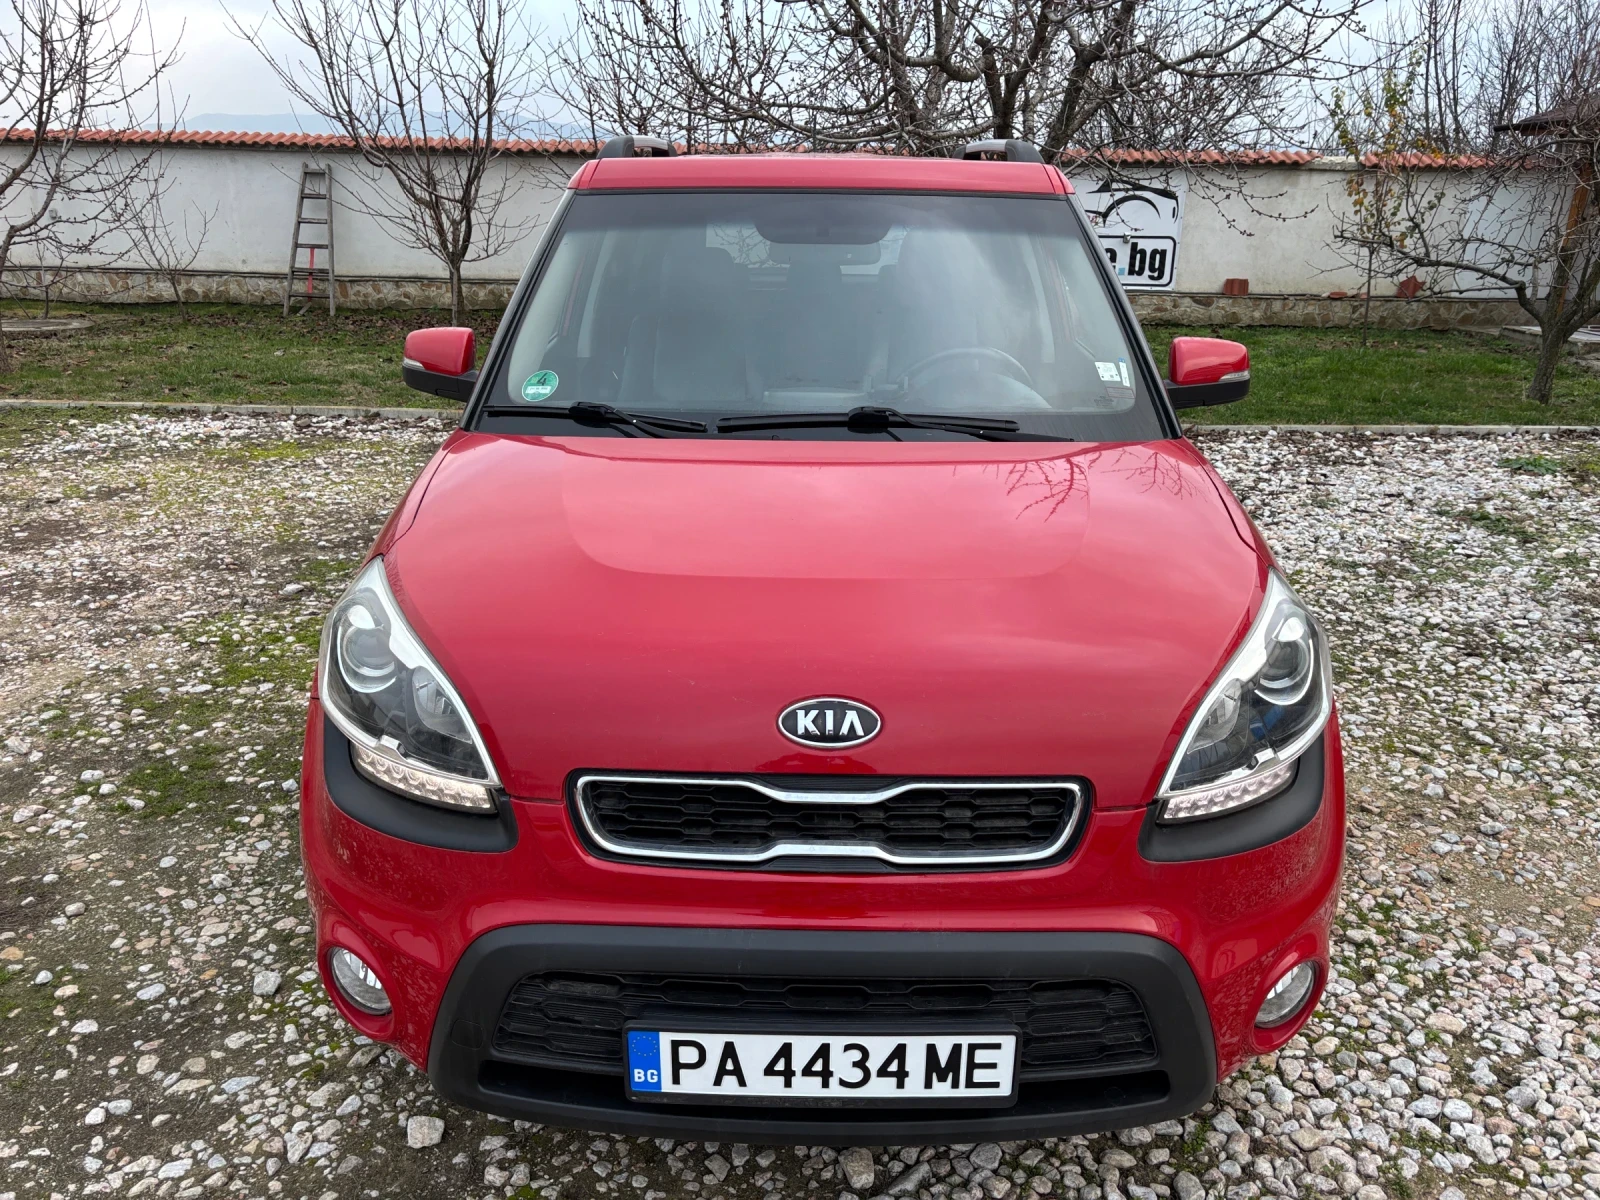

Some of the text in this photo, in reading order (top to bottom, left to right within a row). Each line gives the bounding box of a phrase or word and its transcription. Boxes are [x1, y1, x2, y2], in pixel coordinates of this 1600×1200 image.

[537, 372, 548, 386] 4
[796, 709, 865, 736] KIA
[670, 1040, 1003, 1090] PA 4434 ME
[634, 1068, 659, 1084] BG
